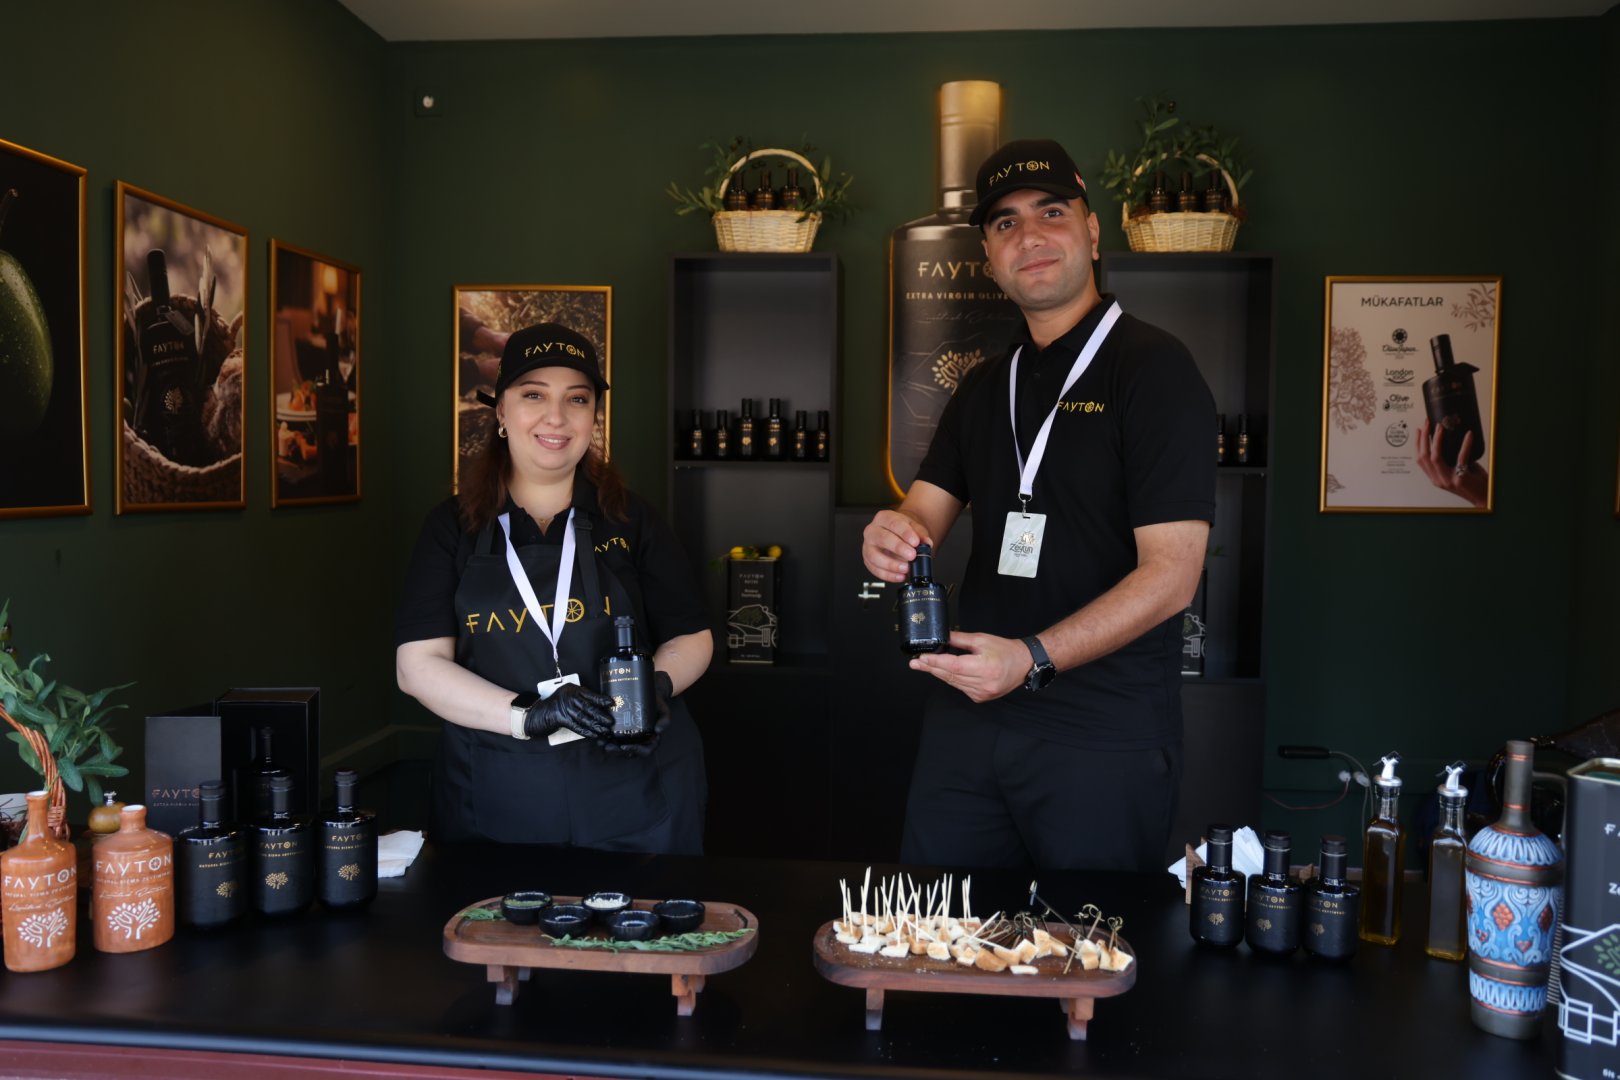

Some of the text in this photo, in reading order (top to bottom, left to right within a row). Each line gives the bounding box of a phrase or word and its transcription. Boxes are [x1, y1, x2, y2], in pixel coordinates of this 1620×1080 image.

[988, 159, 1050, 187] FAYTON
[918, 260, 993, 280] FAYTO
[906, 291, 934, 300] EXTRA
[936, 291, 975, 300] VIRGIN
[1361, 294, 1444, 307] MÜKAFATLAR
[524, 341, 586, 359] FAYTON
[1058, 401, 1105, 413] FAYTON
[594, 537, 630, 553] AYTO
[152, 788, 200, 800] FAYTO
[331, 833, 363, 843] FAYTO
[96, 853, 171, 877] FAYTON
[4, 866, 77, 891] FAYTON
